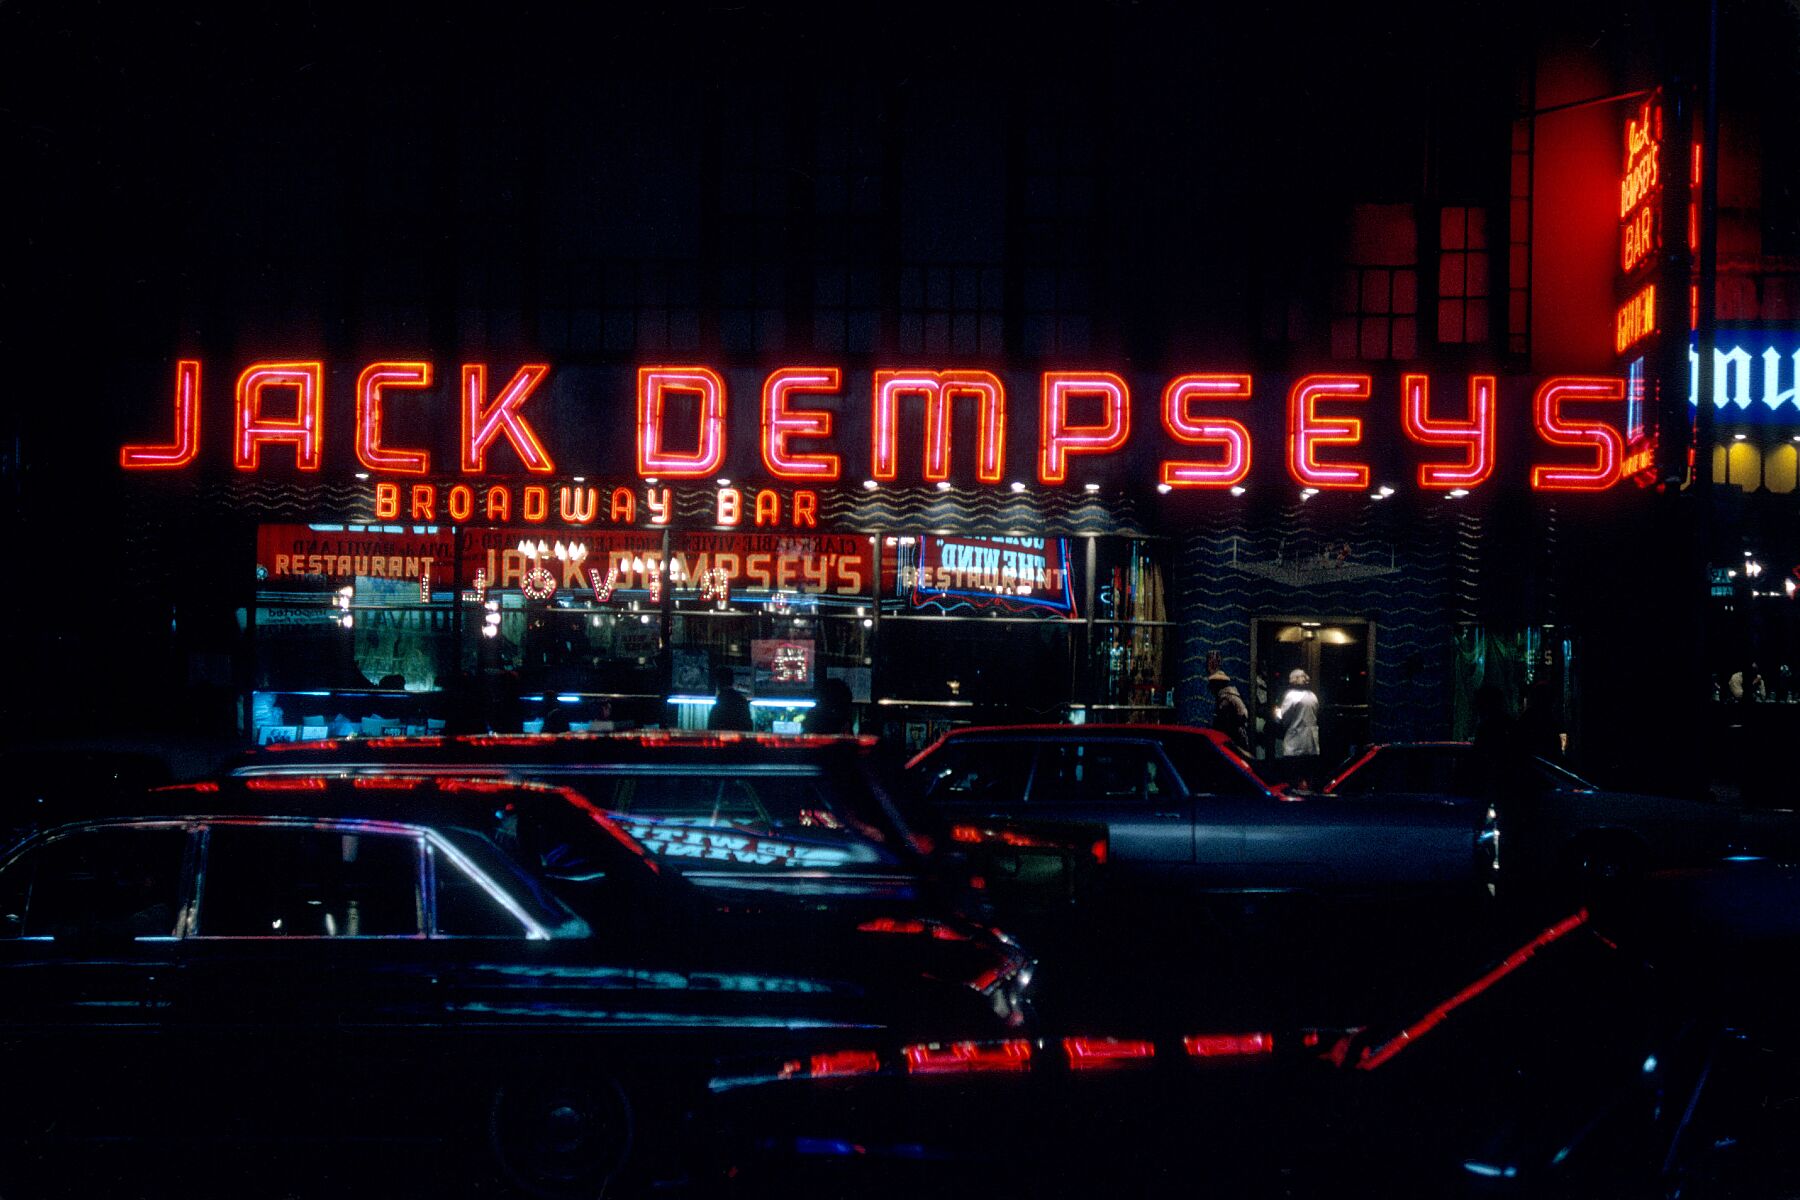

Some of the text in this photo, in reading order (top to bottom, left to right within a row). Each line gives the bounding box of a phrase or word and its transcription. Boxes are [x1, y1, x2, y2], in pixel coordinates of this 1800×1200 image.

[1623, 206, 1651, 272] BAR
[119, 360, 1626, 491] JACK DEMPSEYS
[375, 482, 816, 528] BROADWAY BAR
[275, 553, 434, 579] RESTAURANT
[483, 548, 862, 595] JACK DEMPSEY'S
